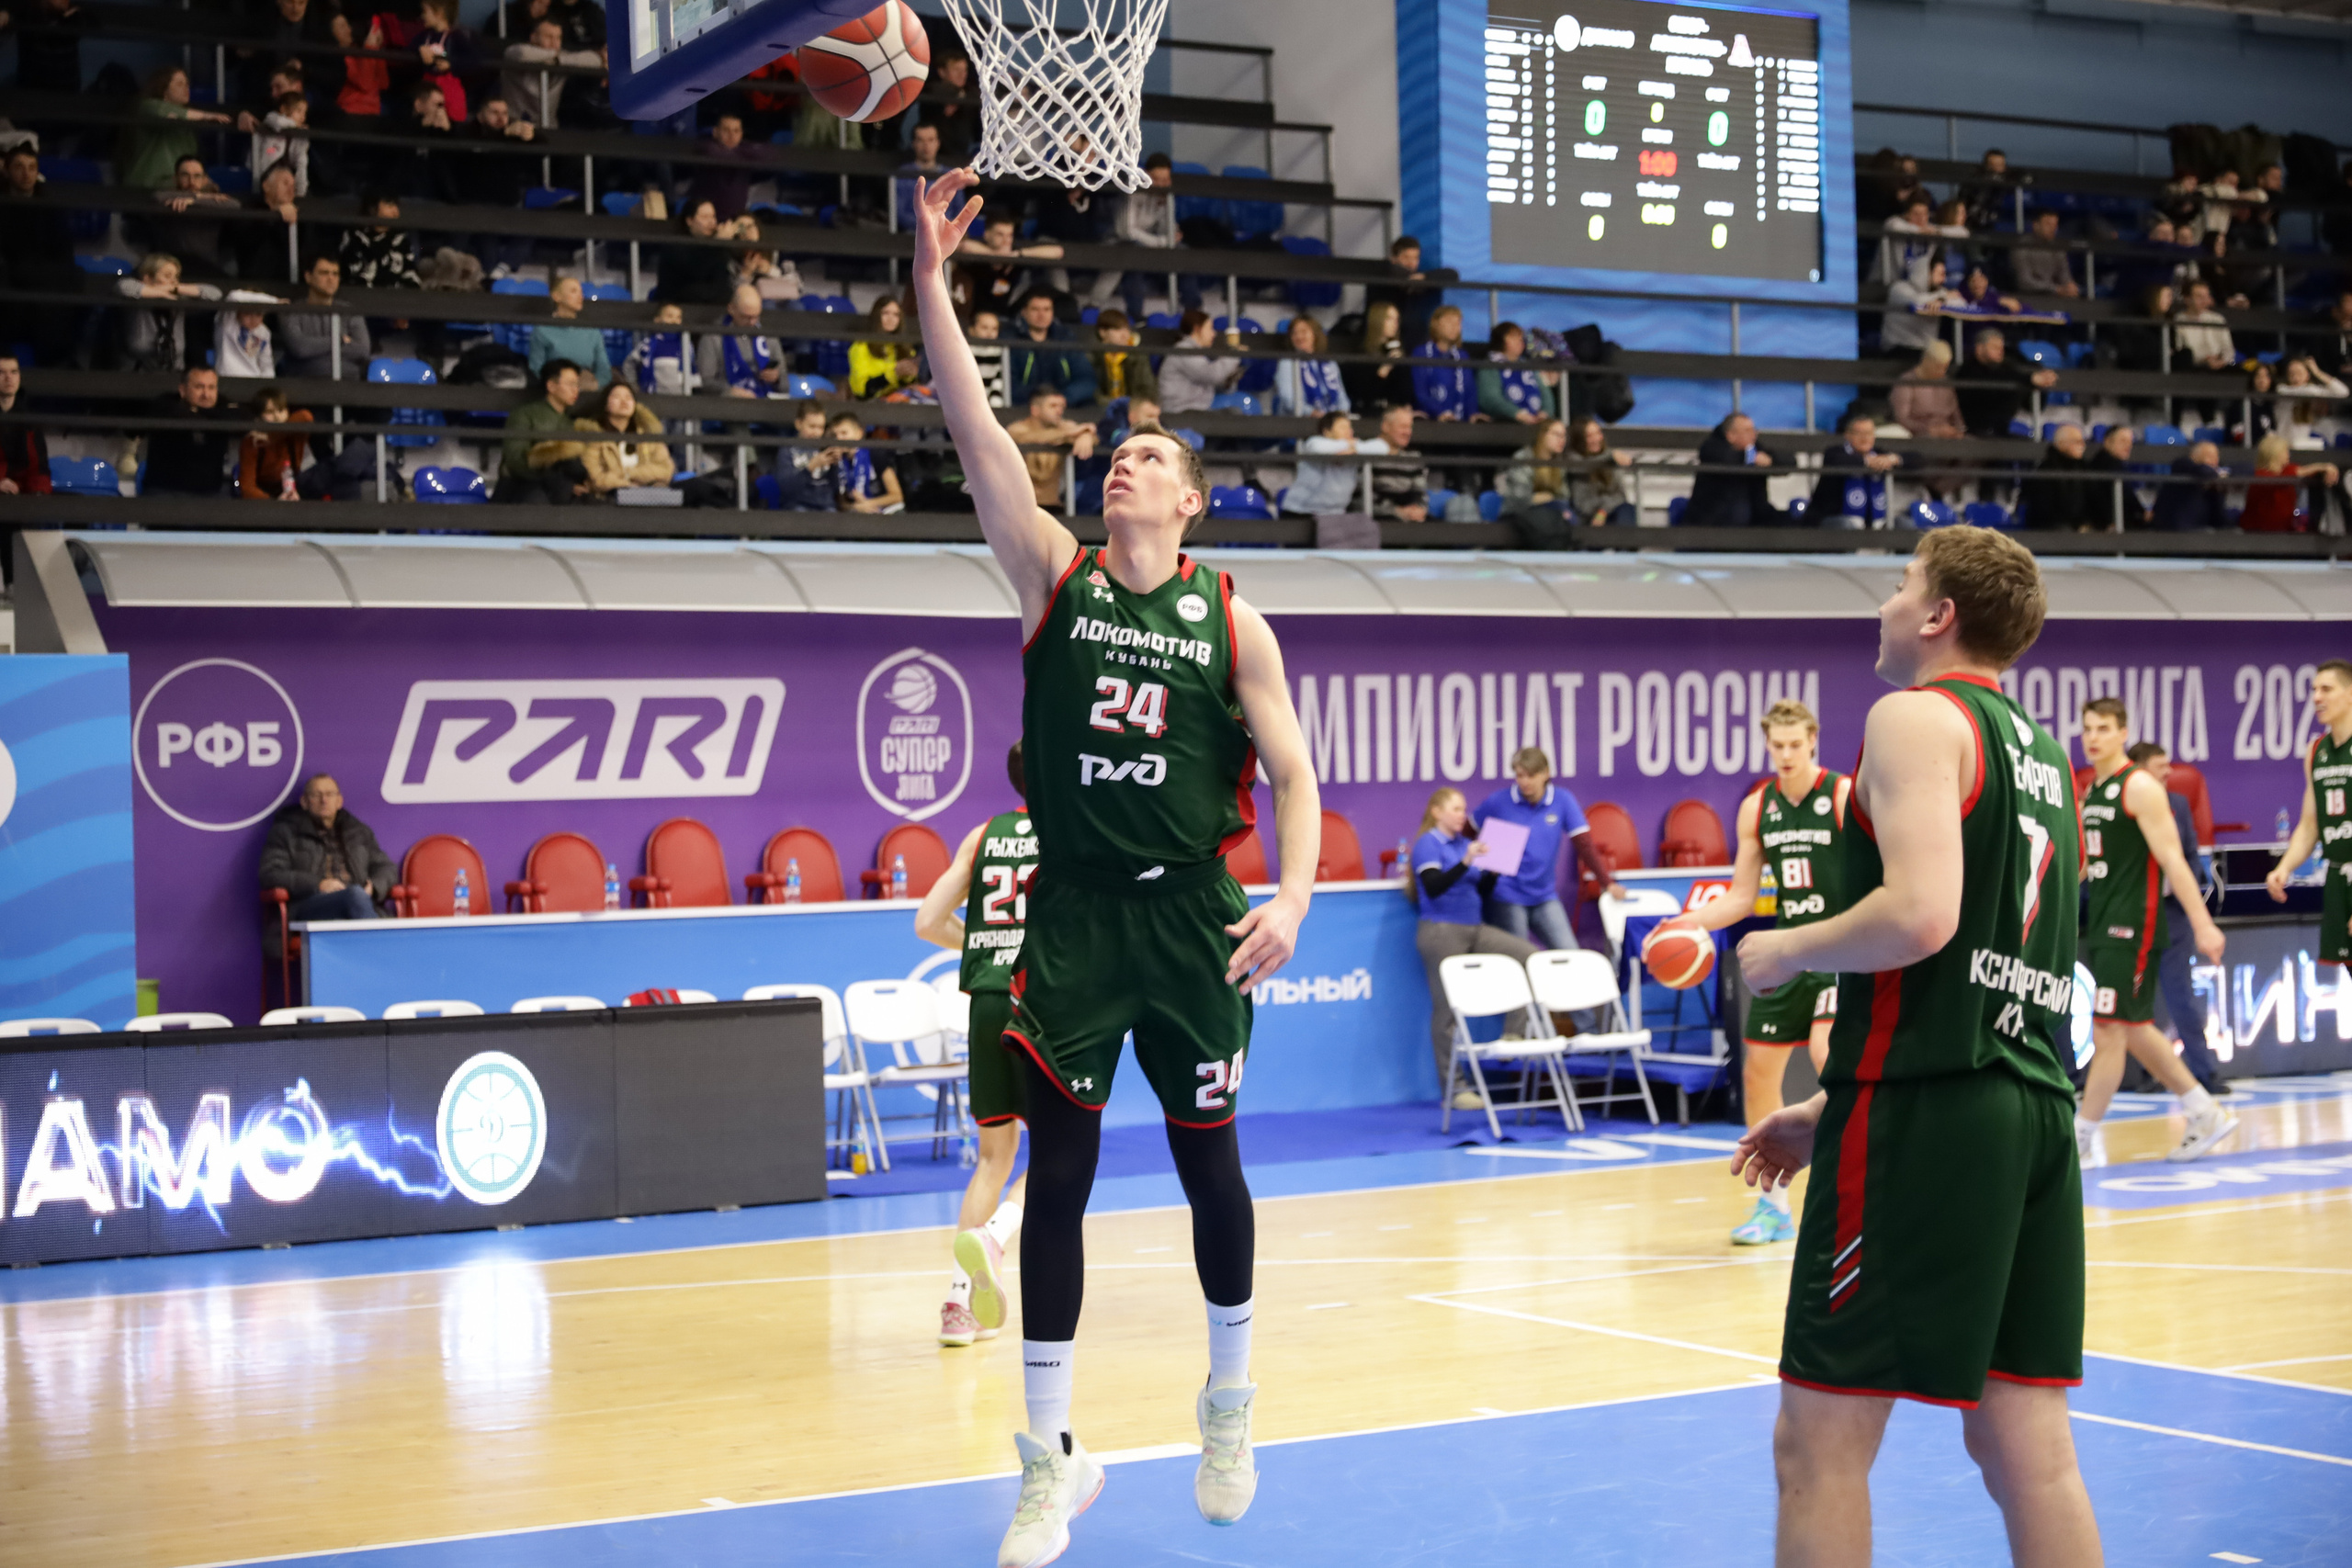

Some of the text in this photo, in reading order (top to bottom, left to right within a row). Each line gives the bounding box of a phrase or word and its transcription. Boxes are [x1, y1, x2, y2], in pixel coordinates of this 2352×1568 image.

[1069, 616, 1212, 667] ЛОКОМОТИВ
[1105, 649, 1172, 671] КУБАНЬ
[1090, 675, 1169, 739] 24
[1259, 673, 1583, 784] МПИОНАТ
[157, 721, 283, 768] РФБ
[401, 694, 765, 784] PARI
[985, 836, 1040, 858] РЫЖЕНК
[1781, 857, 1814, 889] 81
[2018, 814, 2055, 945] 7
[1251, 967, 1373, 1007] ЛЬНЫЙ
[1196, 1046, 1244, 1111] 24
[0, 1093, 328, 1216] АМО
